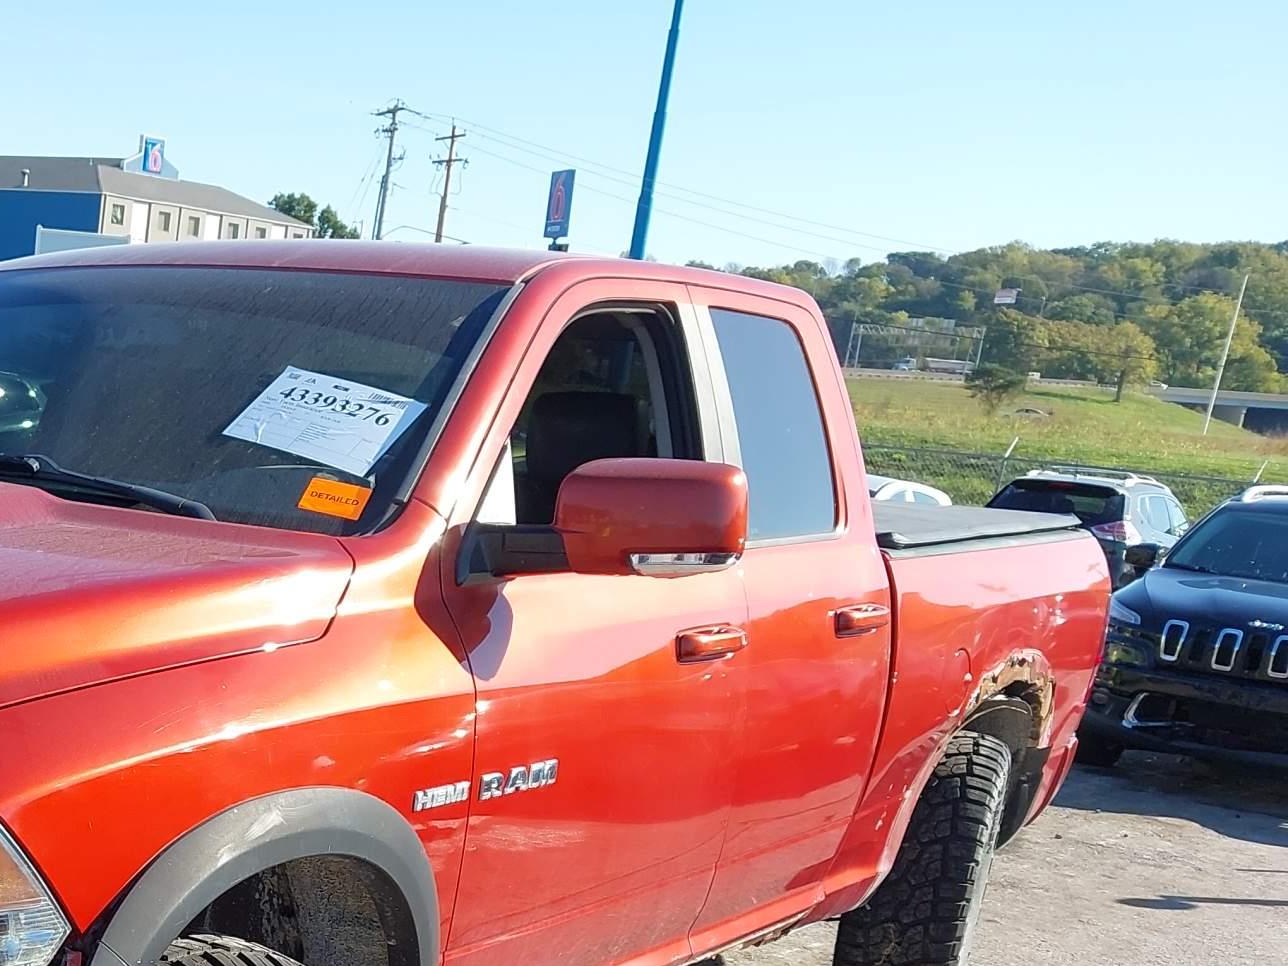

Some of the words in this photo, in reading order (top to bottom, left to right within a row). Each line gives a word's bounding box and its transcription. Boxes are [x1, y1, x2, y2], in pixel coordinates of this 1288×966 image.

[148, 142, 162, 171] 6
[550, 173, 566, 221] 6
[279, 386, 395, 426] 43393276
[310, 490, 360, 507] DETAILED
[479, 758, 560, 801] RAM
